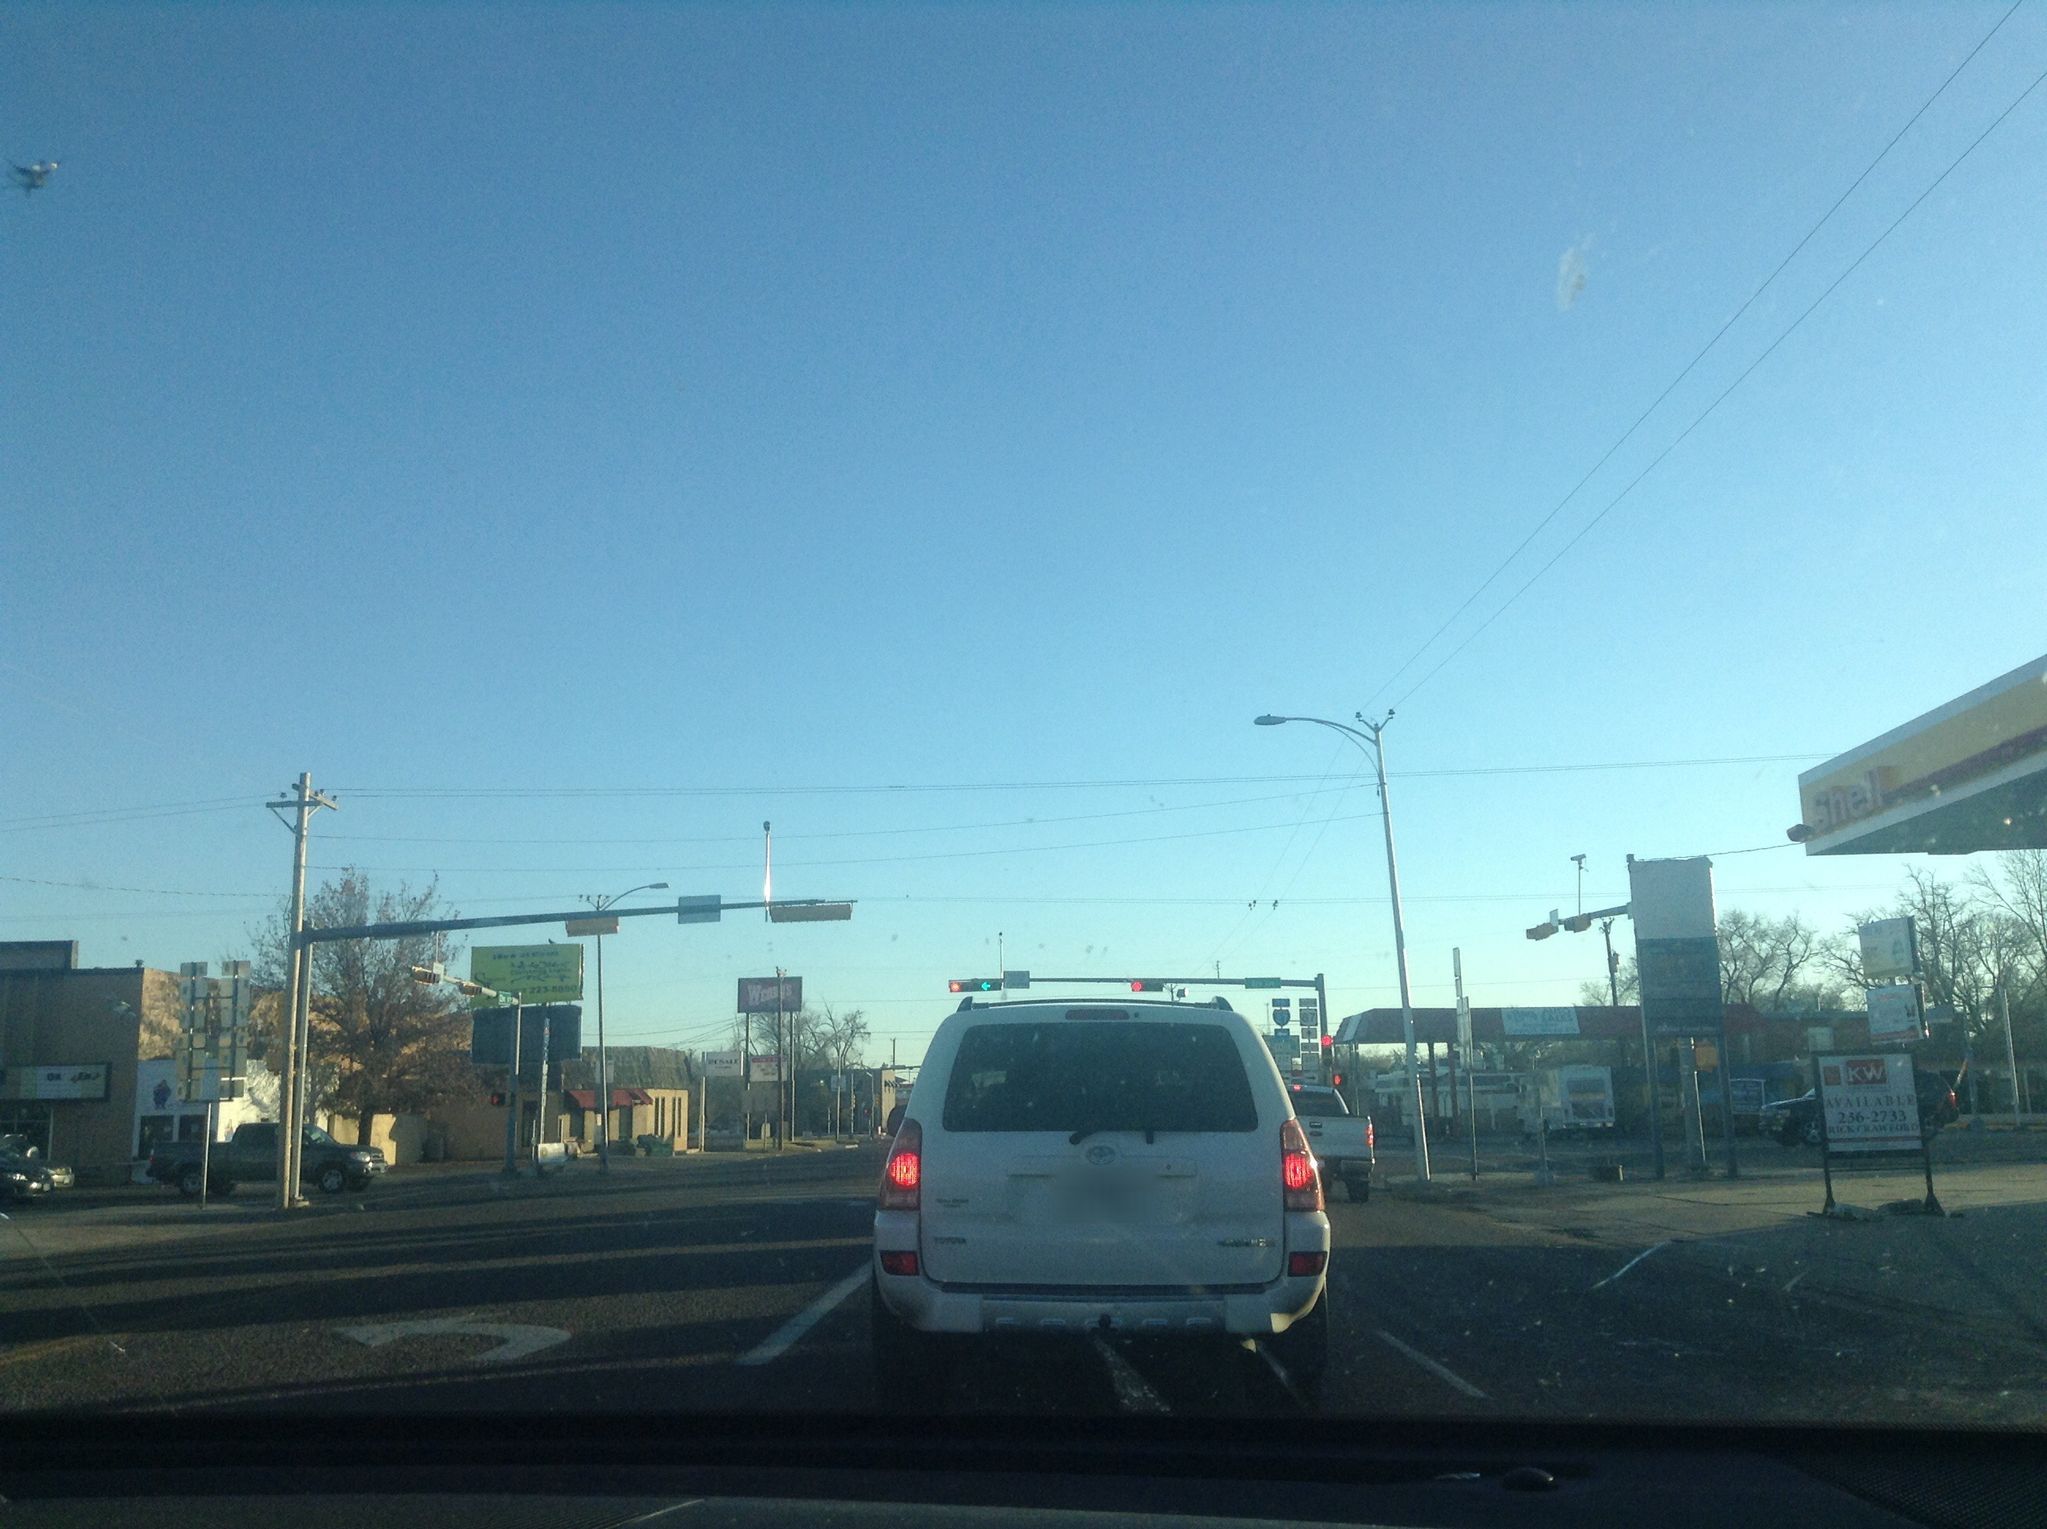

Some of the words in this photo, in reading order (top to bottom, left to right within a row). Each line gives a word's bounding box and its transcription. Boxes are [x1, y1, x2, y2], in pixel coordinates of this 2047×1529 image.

[1816, 767, 1881, 830] Shell
[1848, 1063, 1883, 1082] KW
[1827, 1095, 1916, 1108] AVAILABLE
